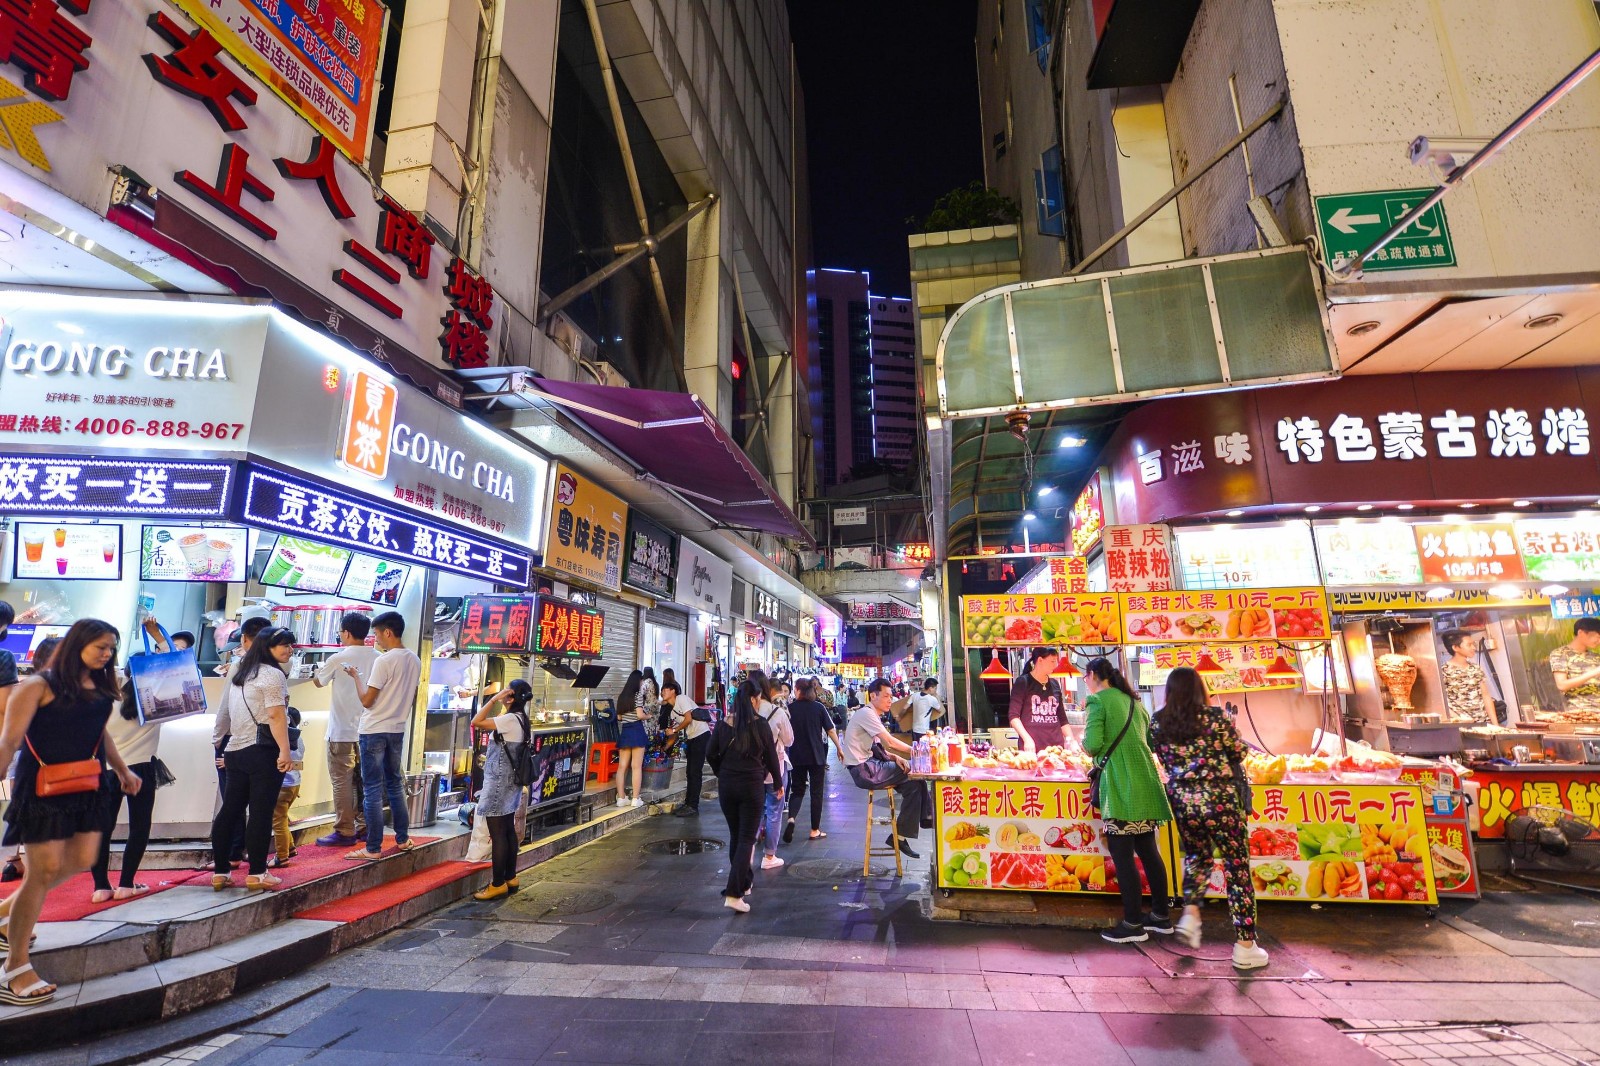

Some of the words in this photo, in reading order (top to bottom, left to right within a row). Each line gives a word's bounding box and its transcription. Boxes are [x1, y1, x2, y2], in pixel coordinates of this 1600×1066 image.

[1334, 243, 1446, 263] 反恐急疏散通道
[4, 339, 130, 377] GONG
[143, 346, 230, 380] CHA
[1139, 432, 1253, 485] 百滋味
[1277, 406, 1592, 465] 特色蒙古烧烤
[391, 422, 465, 481] GONG
[473, 461, 515, 504] CHA
[1110, 527, 1165, 548] 重庆
[1049, 558, 1086, 576] 黄金
[1106, 548, 1170, 580] 酸辣粉
[1051, 577, 1087, 593] 脆皮
[967, 597, 1037, 614] 酸甜水果
[1044, 596, 1116, 614] 10元一斤
[1128, 593, 1218, 612] 酸甜水果
[1225, 590, 1320, 610] 10元一斤
[1555, 597, 1600, 618] 章鱼小
[462, 602, 529, 647] 臭豆腐
[941, 784, 1045, 818] 酸甜水果
[1298, 789, 1416, 825] 10元一斤
